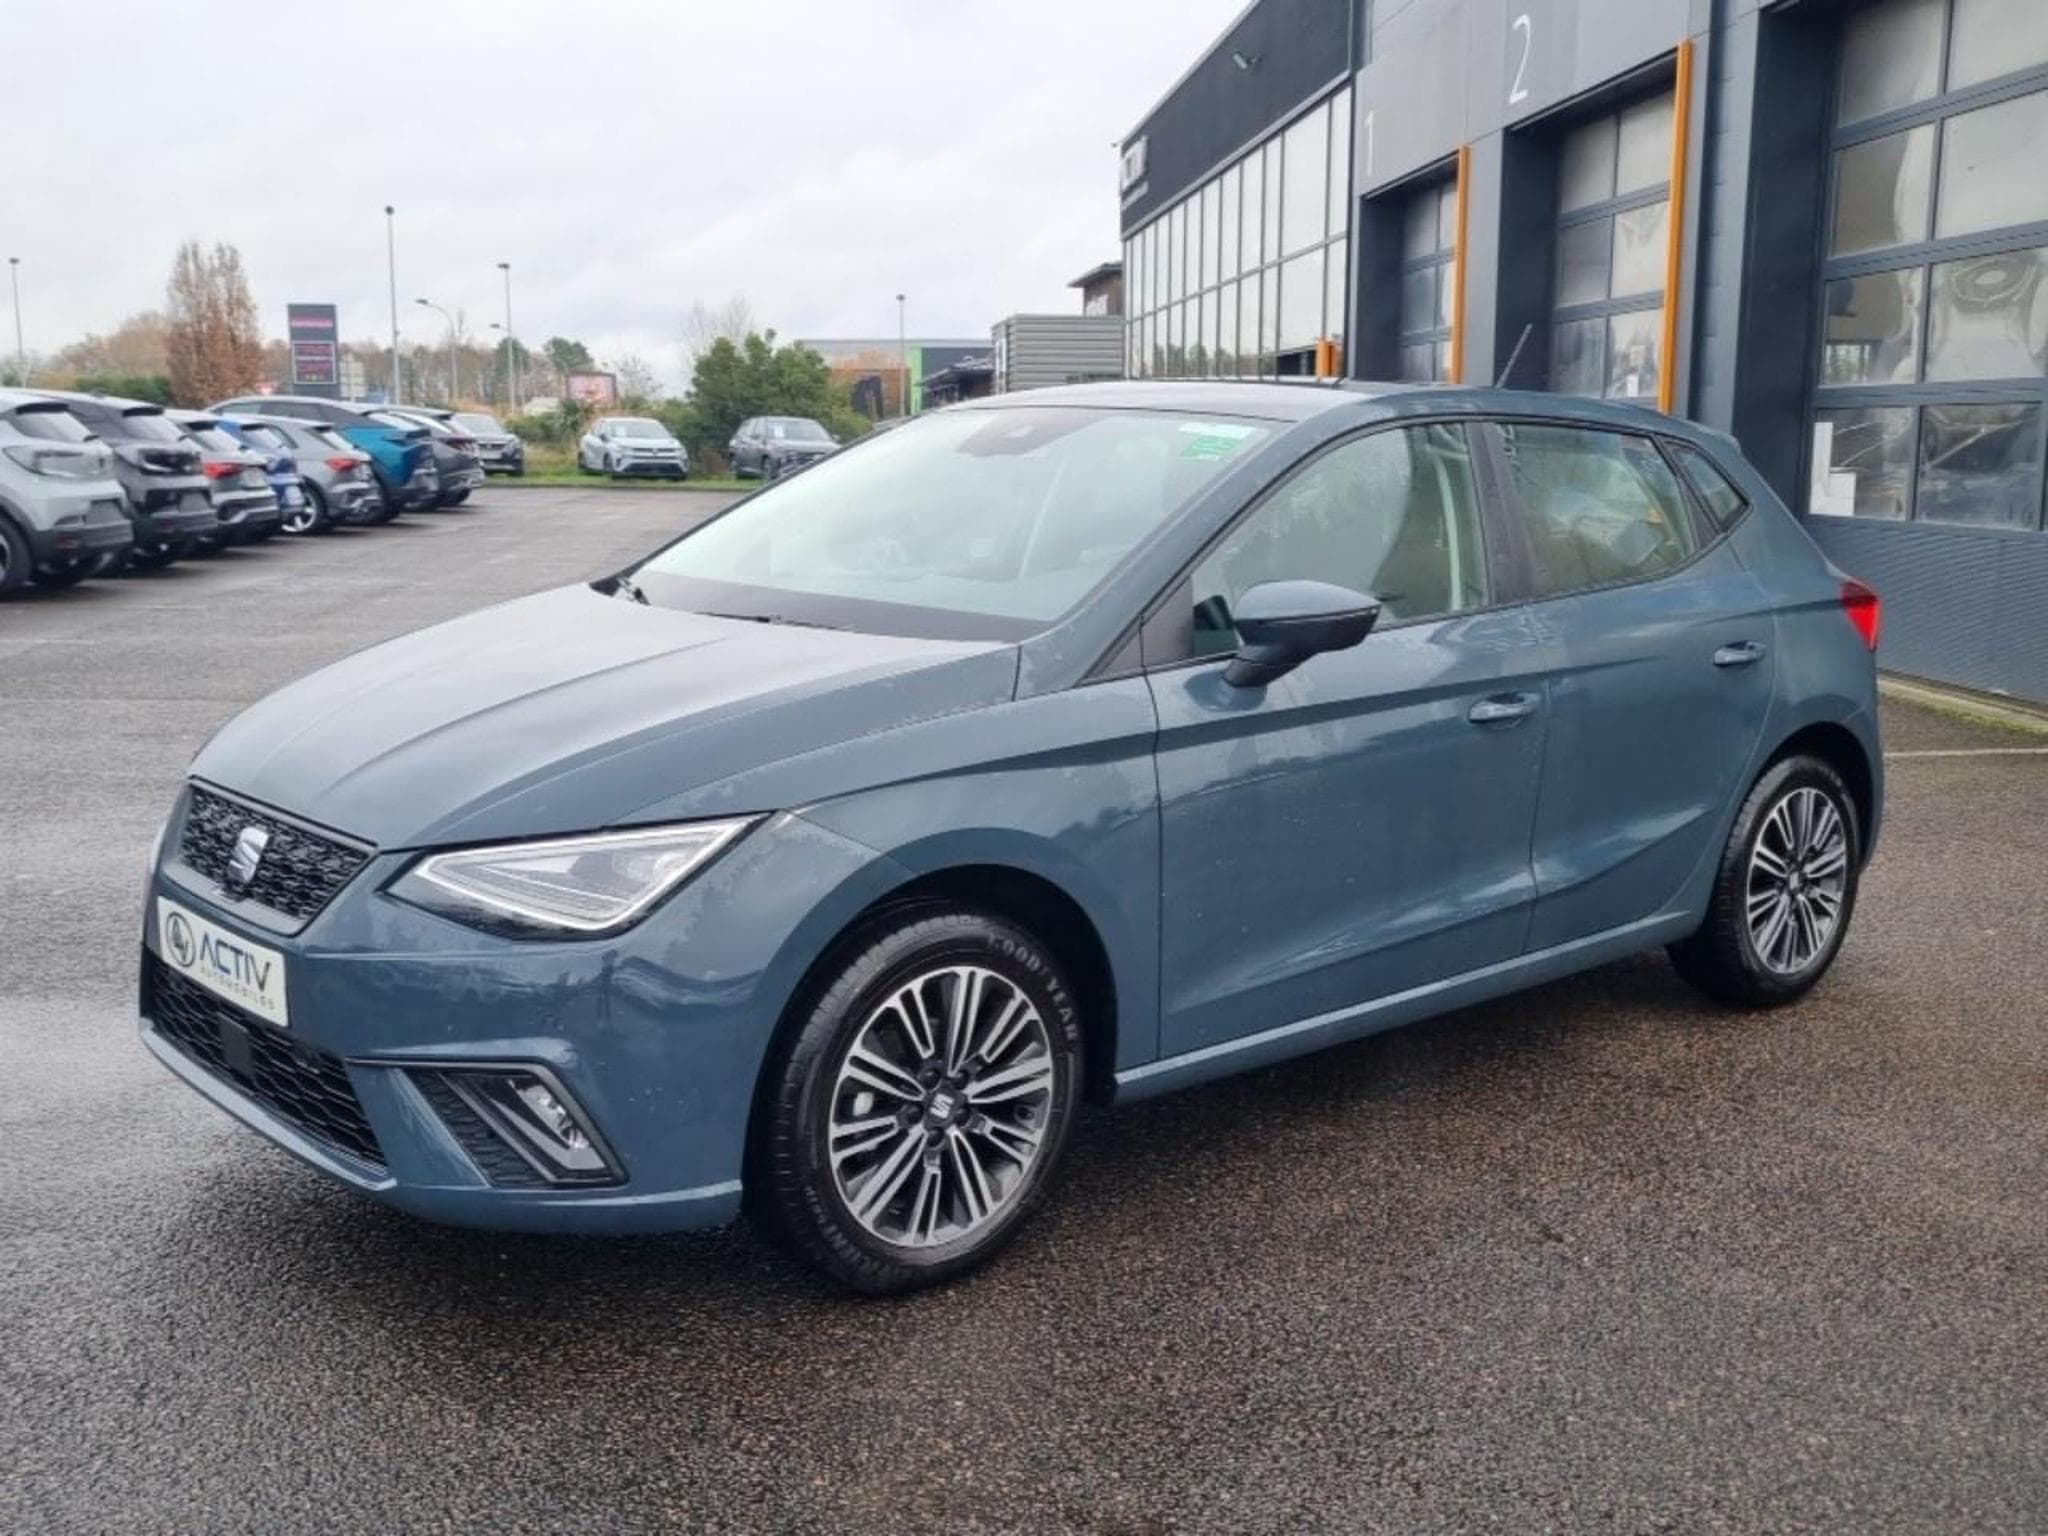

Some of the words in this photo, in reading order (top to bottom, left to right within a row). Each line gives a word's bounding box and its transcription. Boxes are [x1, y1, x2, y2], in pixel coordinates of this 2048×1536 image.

[1509, 14, 1531, 104] 2
[1365, 111, 1374, 176] 1
[199, 932, 271, 992] ACTIV
